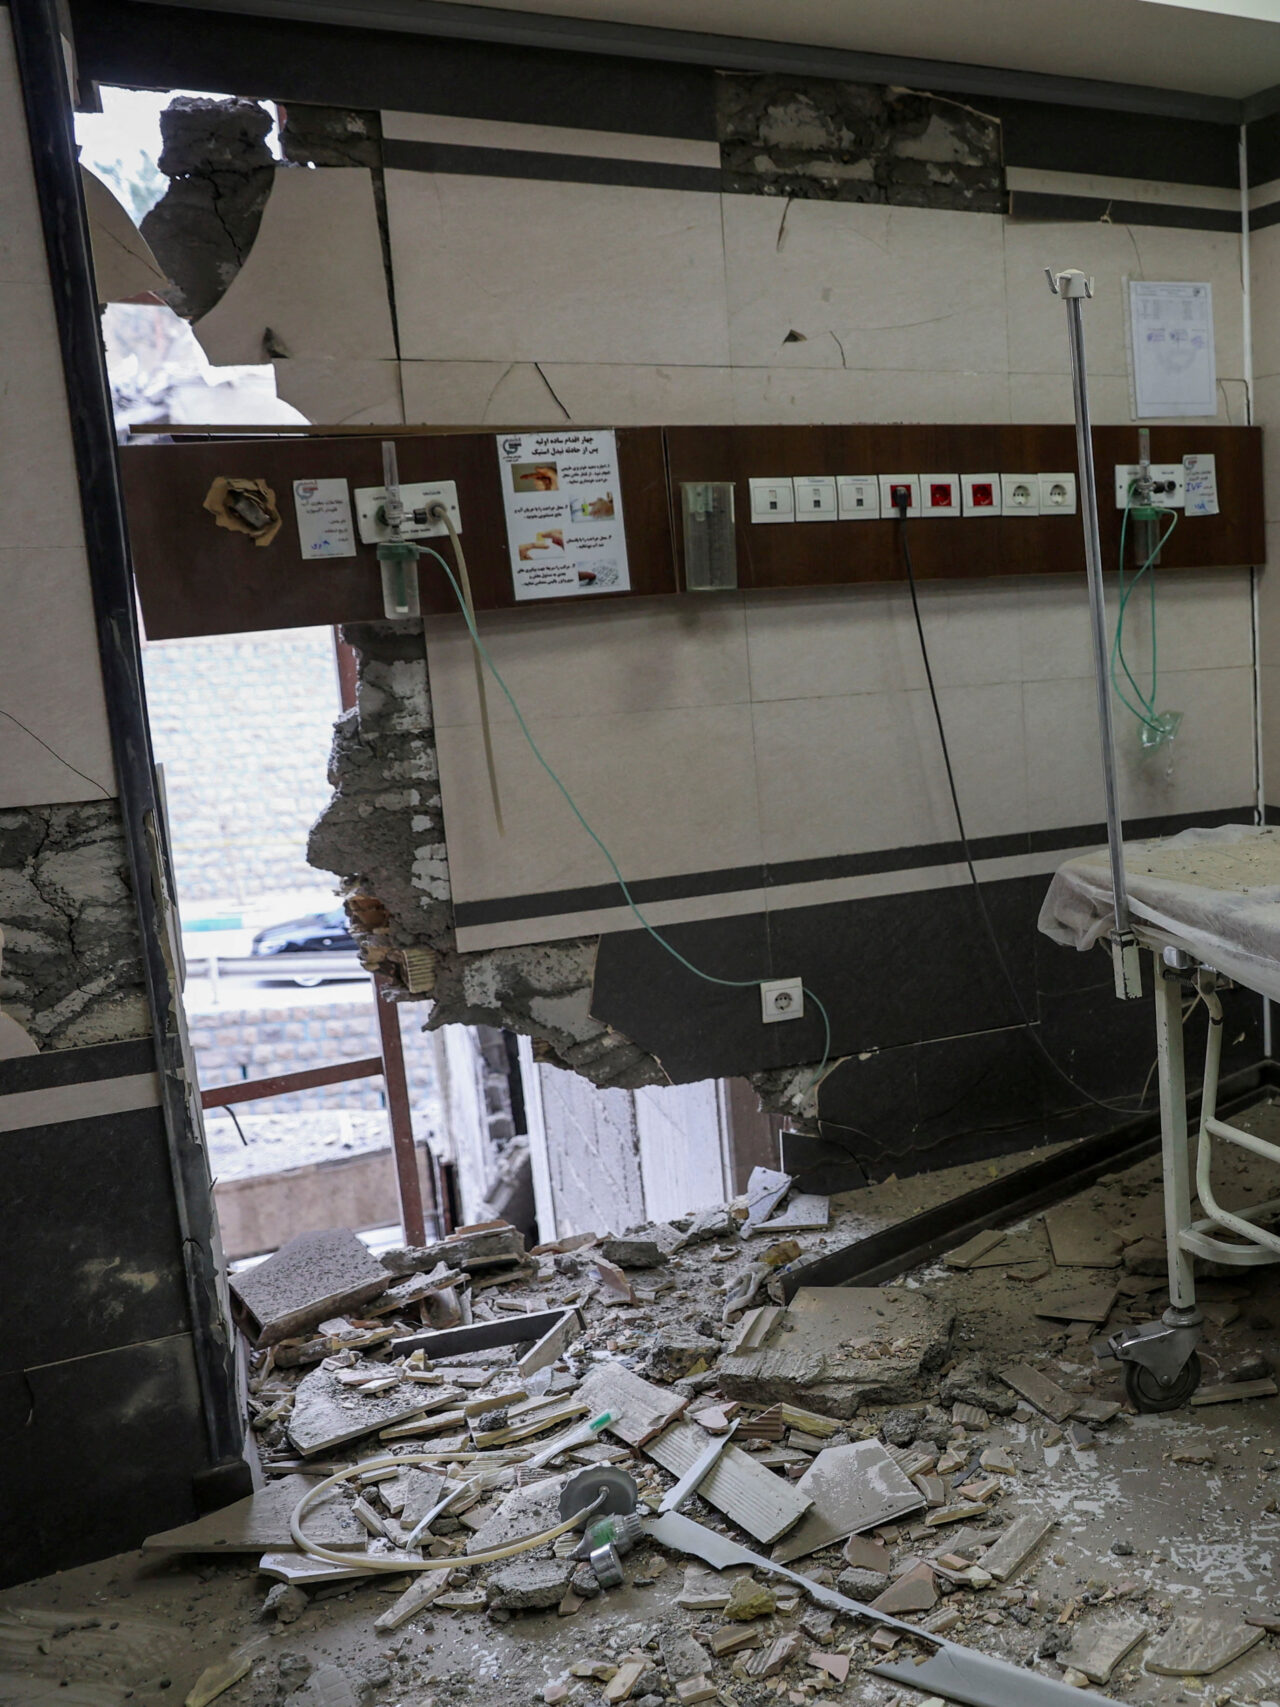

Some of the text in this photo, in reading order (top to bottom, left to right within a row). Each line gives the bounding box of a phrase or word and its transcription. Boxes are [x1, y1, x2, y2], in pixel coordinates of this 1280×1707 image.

[536, 438, 549, 446] اولیه
[565, 436, 580, 445] اقدام
[581, 436, 594, 445] چهار
[550, 448, 564, 456] نیدل
[582, 446, 587, 455] از
